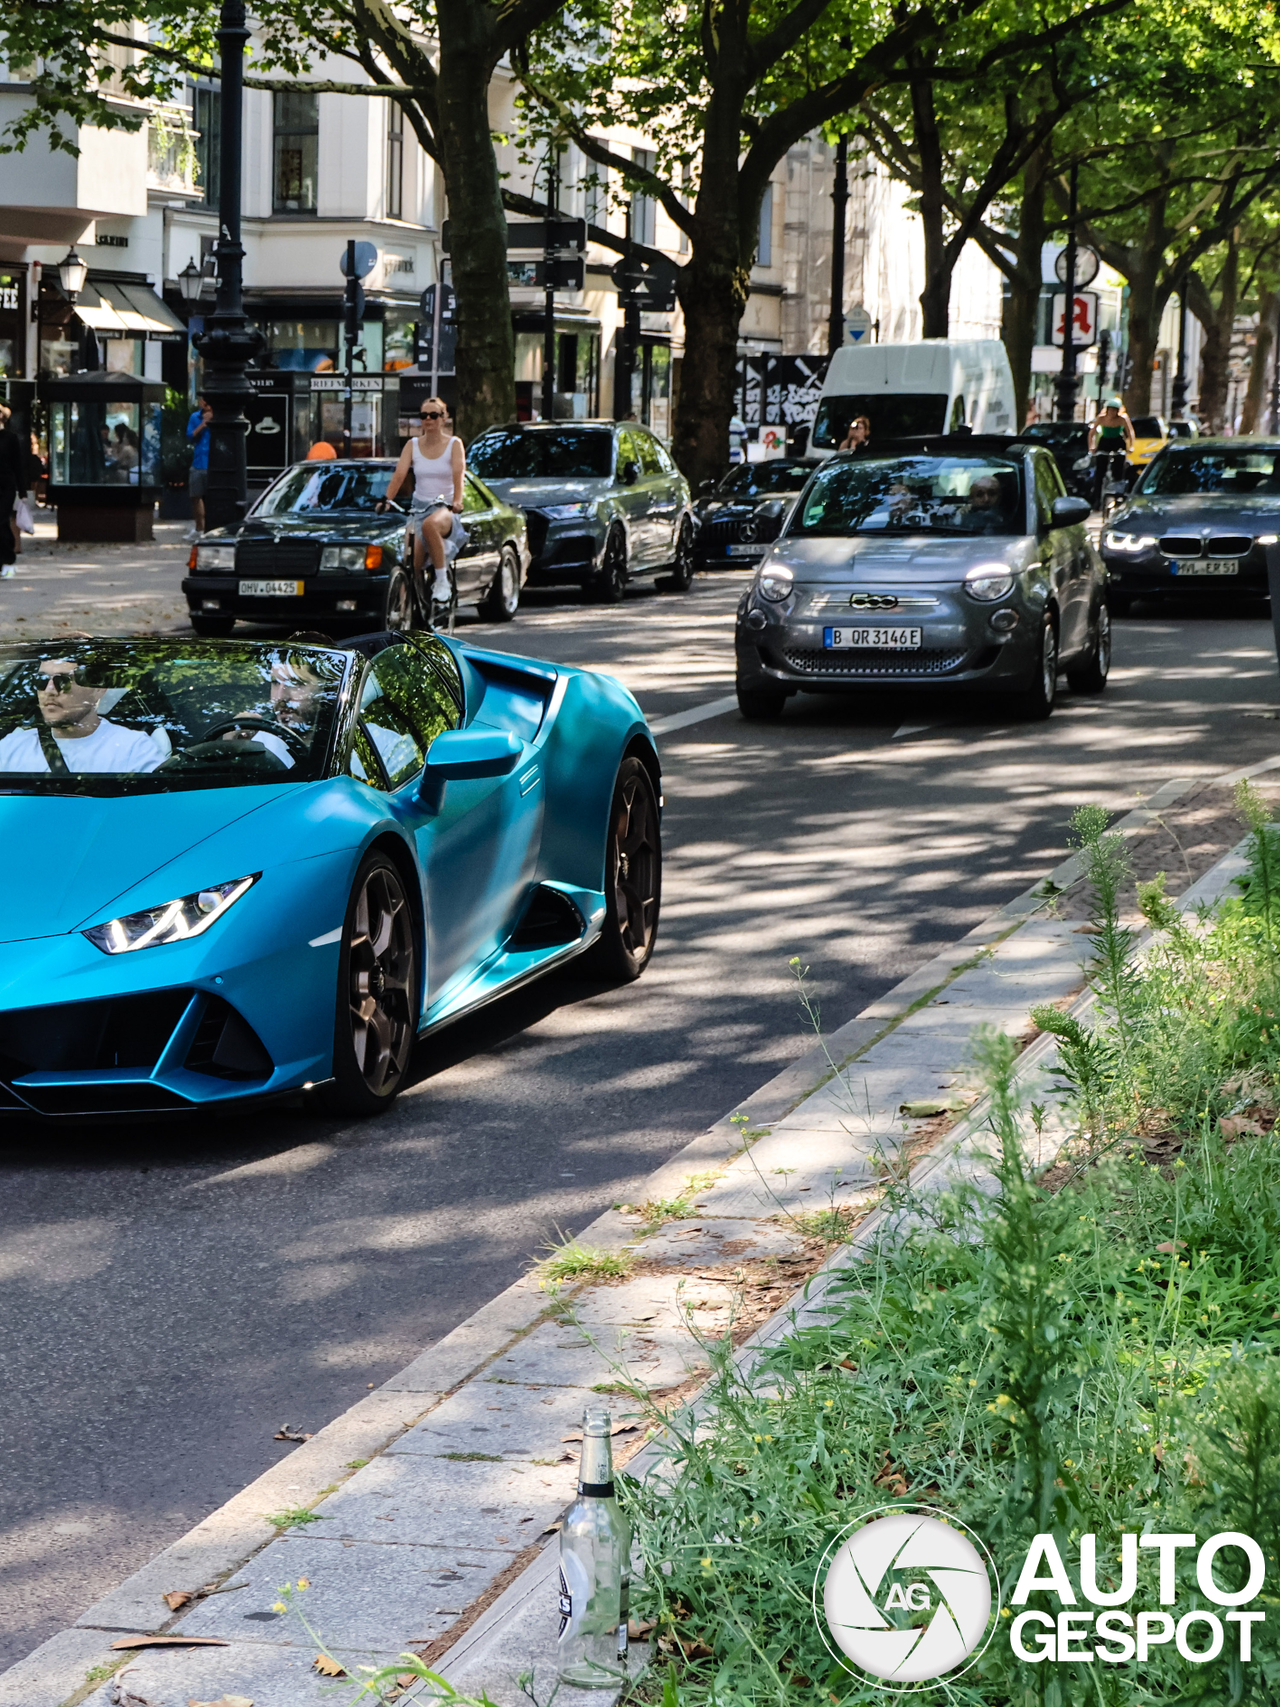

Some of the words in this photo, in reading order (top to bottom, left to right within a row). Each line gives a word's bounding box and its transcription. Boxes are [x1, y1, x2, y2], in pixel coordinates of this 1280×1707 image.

[310, 379, 382, 390] RIEFMRKEN
[265, 582, 295, 594] 04425
[849, 592, 898, 610] 500
[833, 629, 842, 645] B
[852, 629, 870, 645] QR
